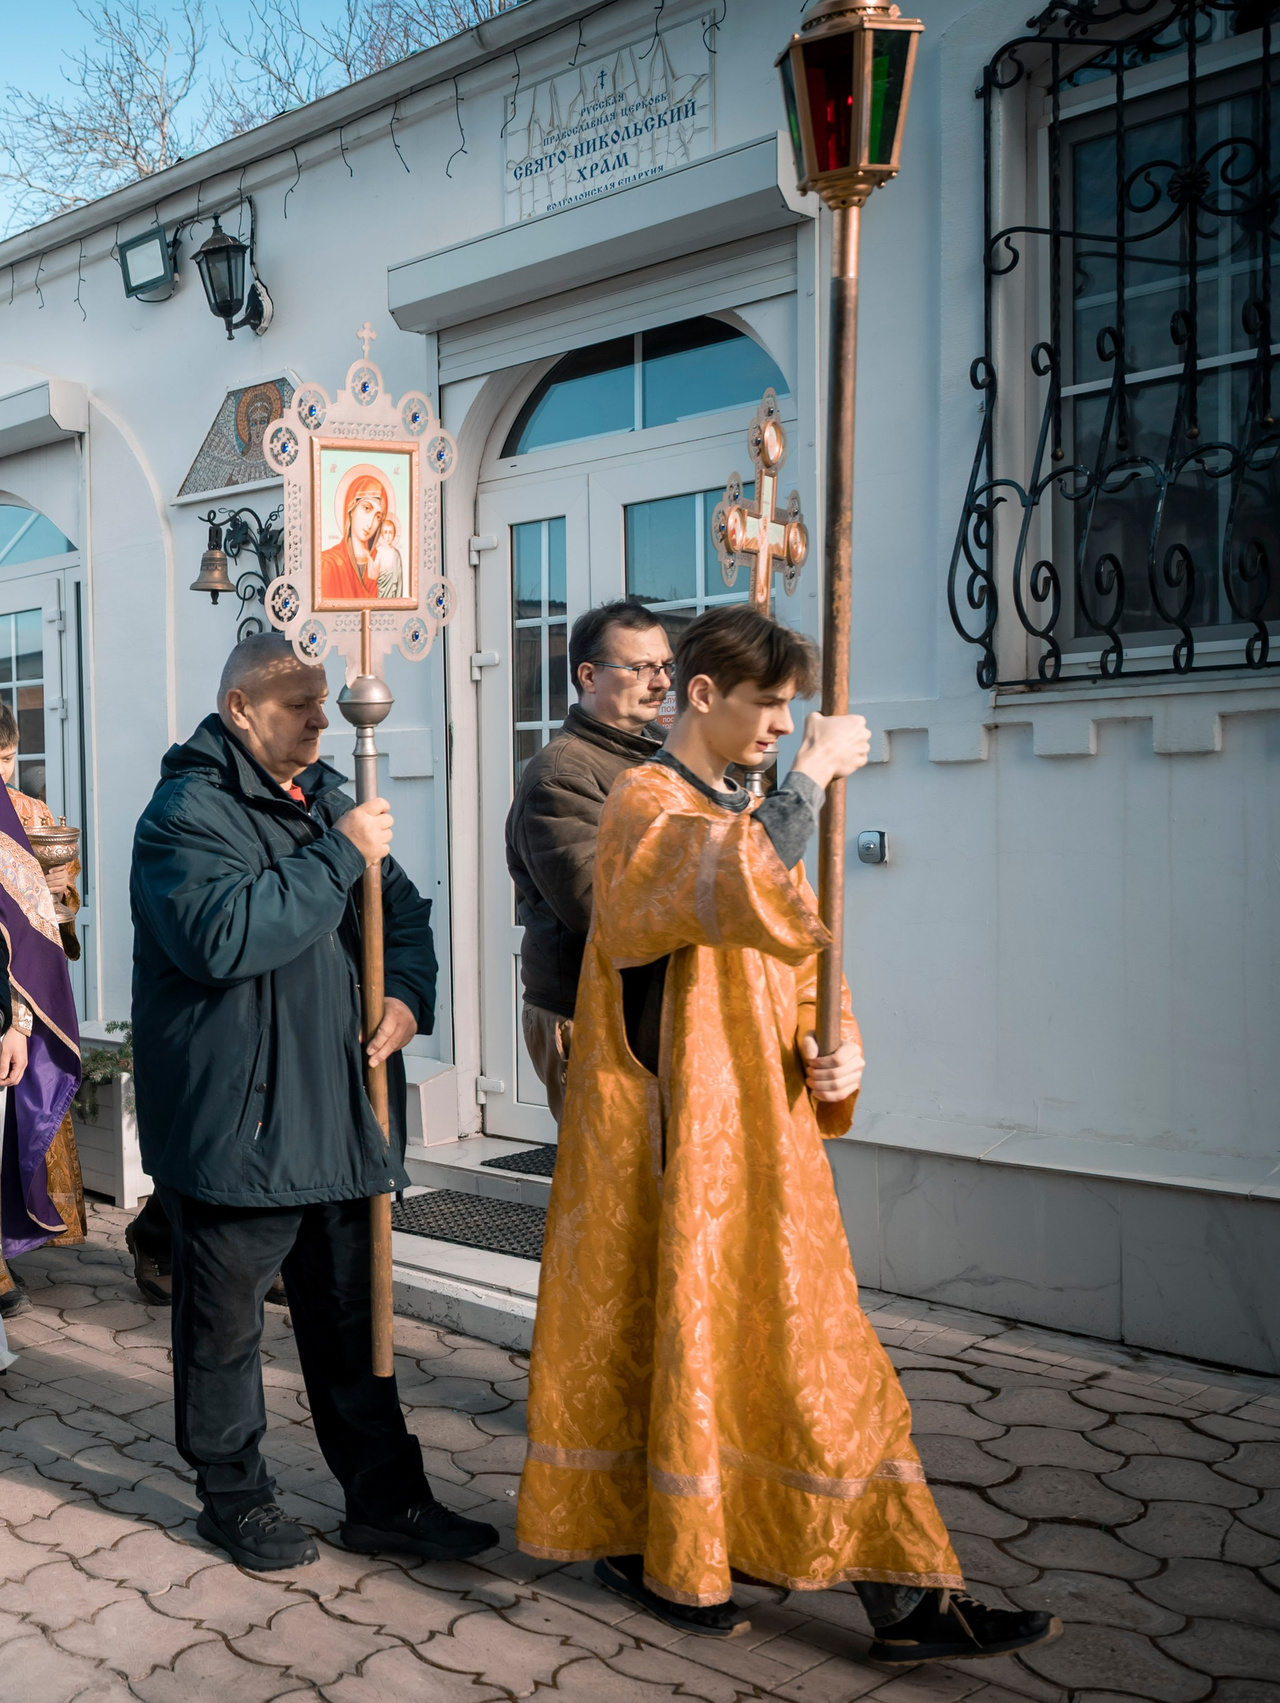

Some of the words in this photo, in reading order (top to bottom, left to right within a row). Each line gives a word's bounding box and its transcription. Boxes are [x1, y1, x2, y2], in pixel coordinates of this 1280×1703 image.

[543, 112, 617, 147] ПРАВОСЛАВНАЯ
[621, 92, 668, 118] ЦЕРКОВЬ
[580, 93, 625, 117] РУССКАЯ
[513, 98, 697, 182] СВЯТО-НИКОЛЬСКИЙ
[576, 151, 630, 183] ХРАМ
